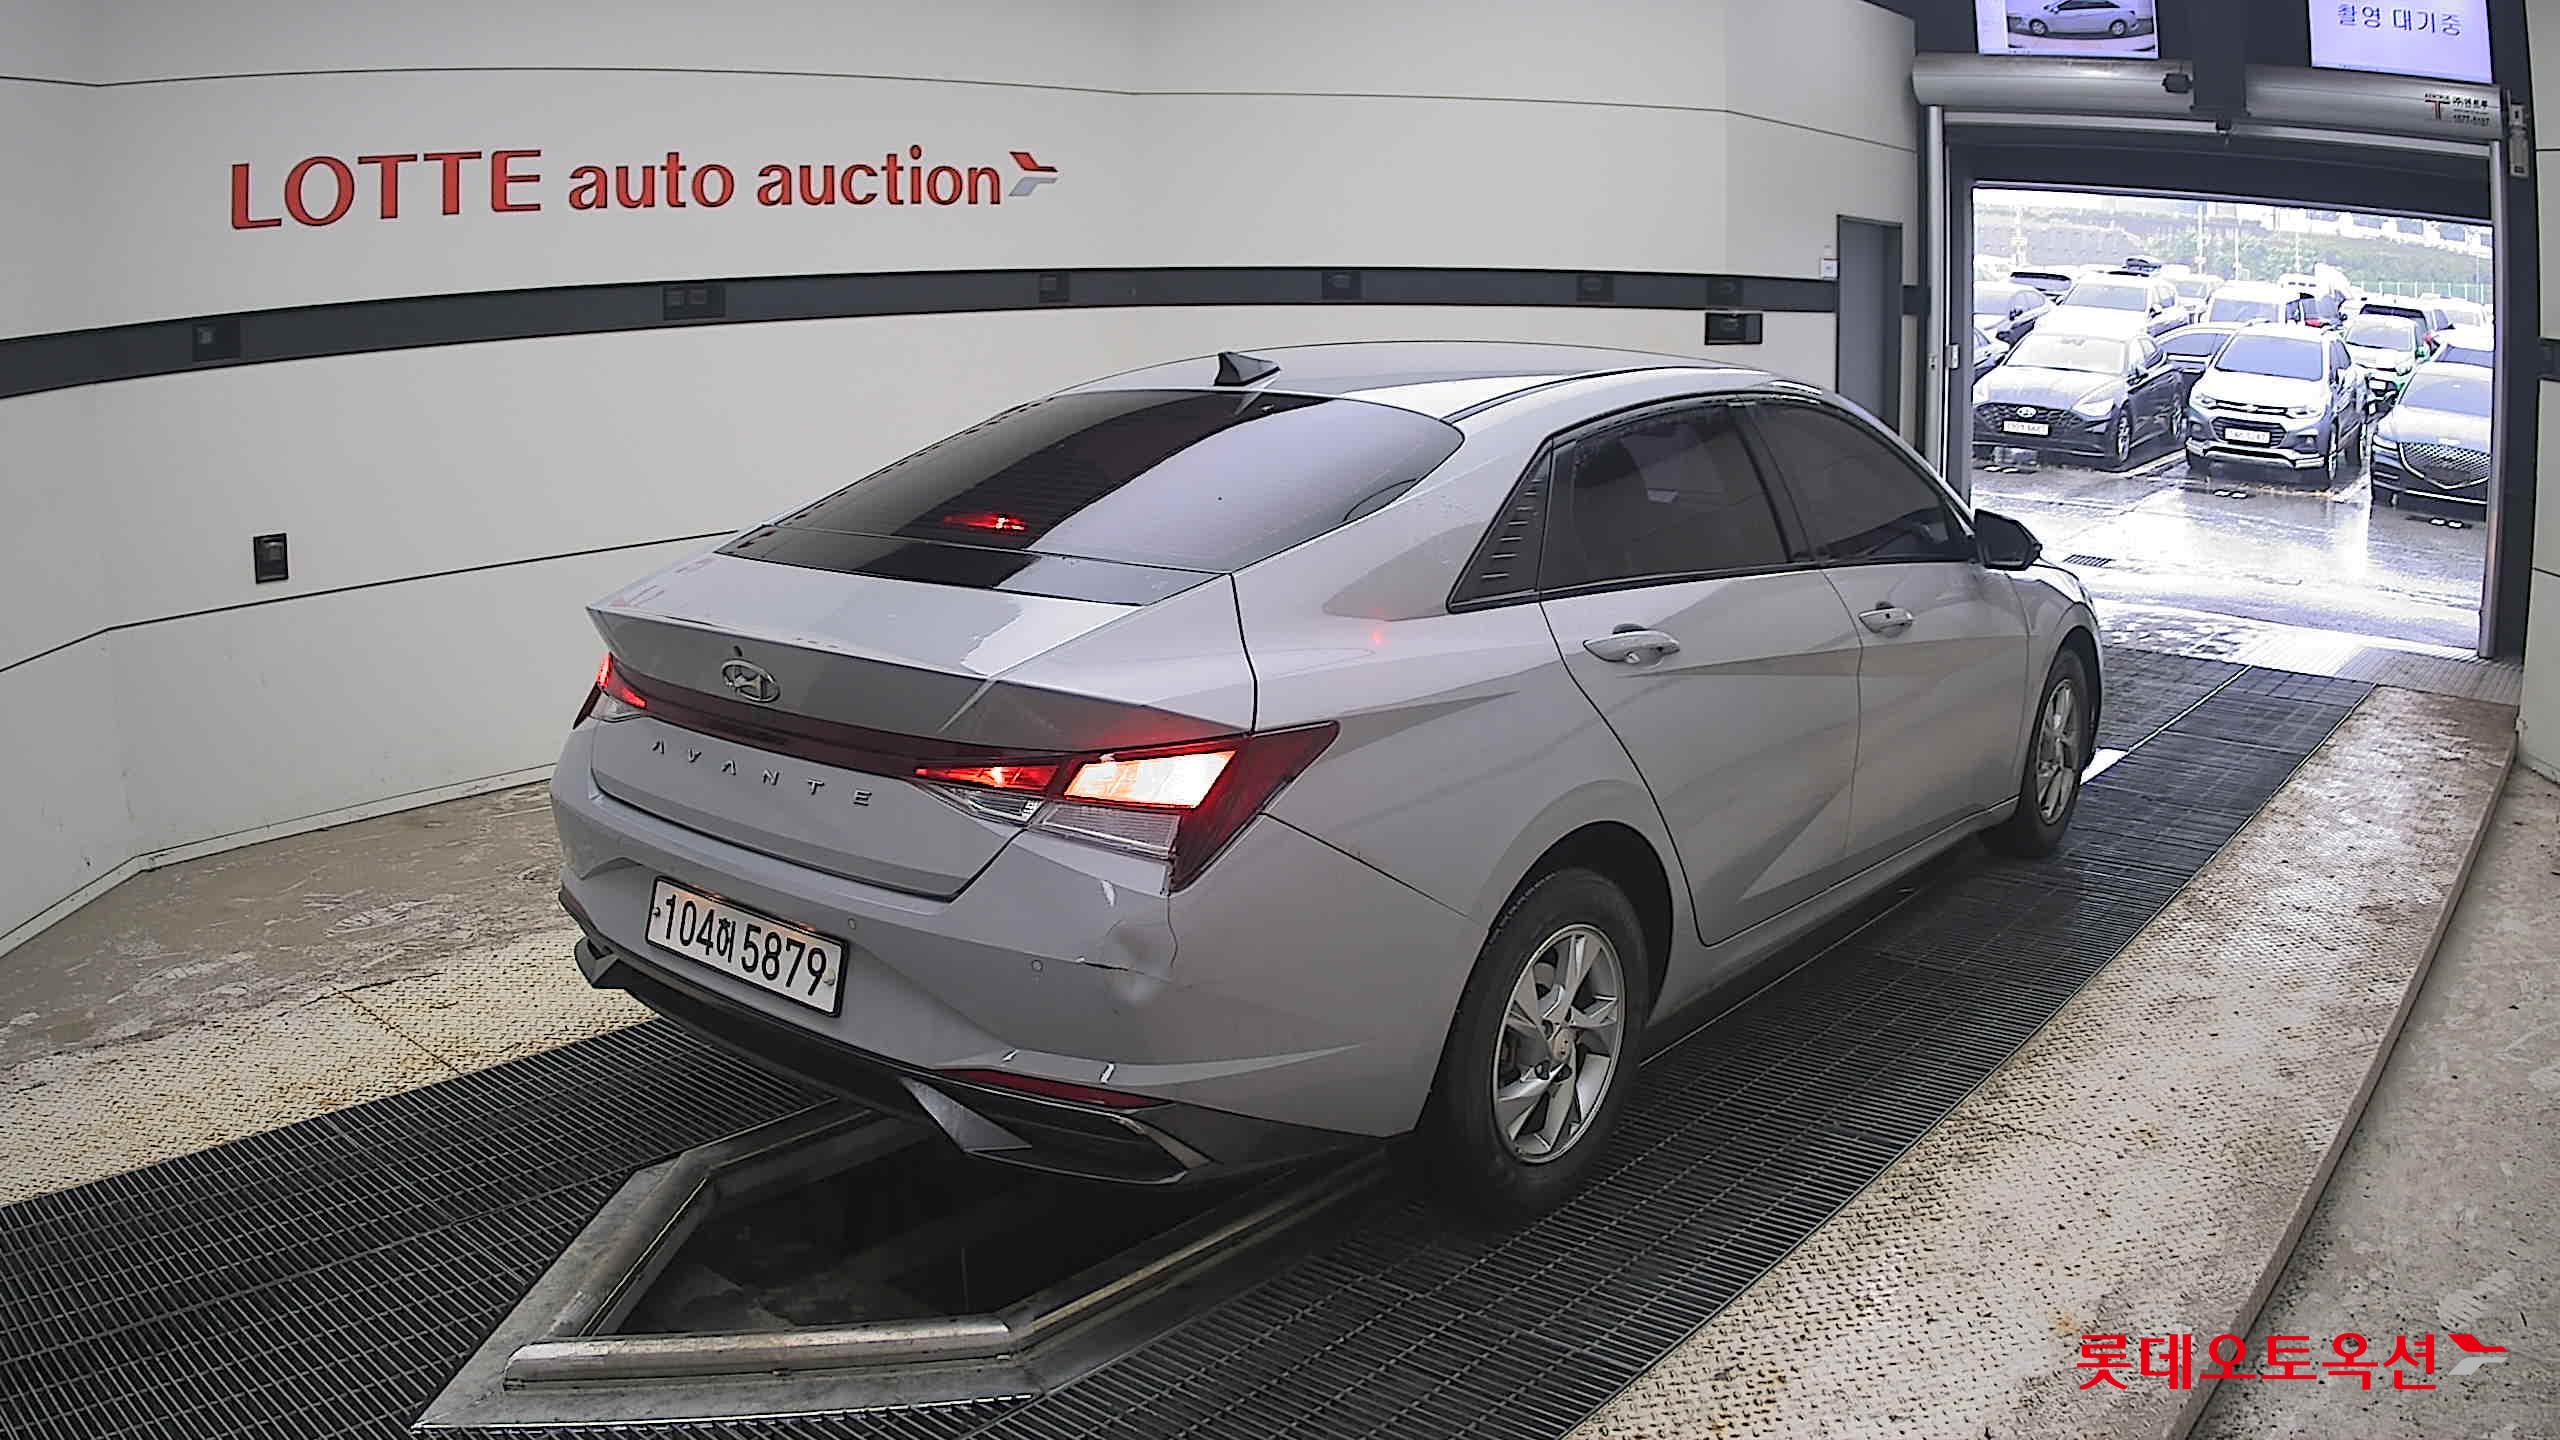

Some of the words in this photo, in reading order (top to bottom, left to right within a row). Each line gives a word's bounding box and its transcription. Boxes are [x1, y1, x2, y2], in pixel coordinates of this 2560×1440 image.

[2338, 5, 2382, 29] 촬영
[2393, 9, 2461, 37] 대기중
[231, 149, 541, 230] LOTTE
[568, 151, 735, 209] auto
[756, 144, 1001, 206] auction
[651, 739, 872, 807] AVANTE
[664, 893, 738, 964] 104허
[740, 922, 829, 997] 5879
